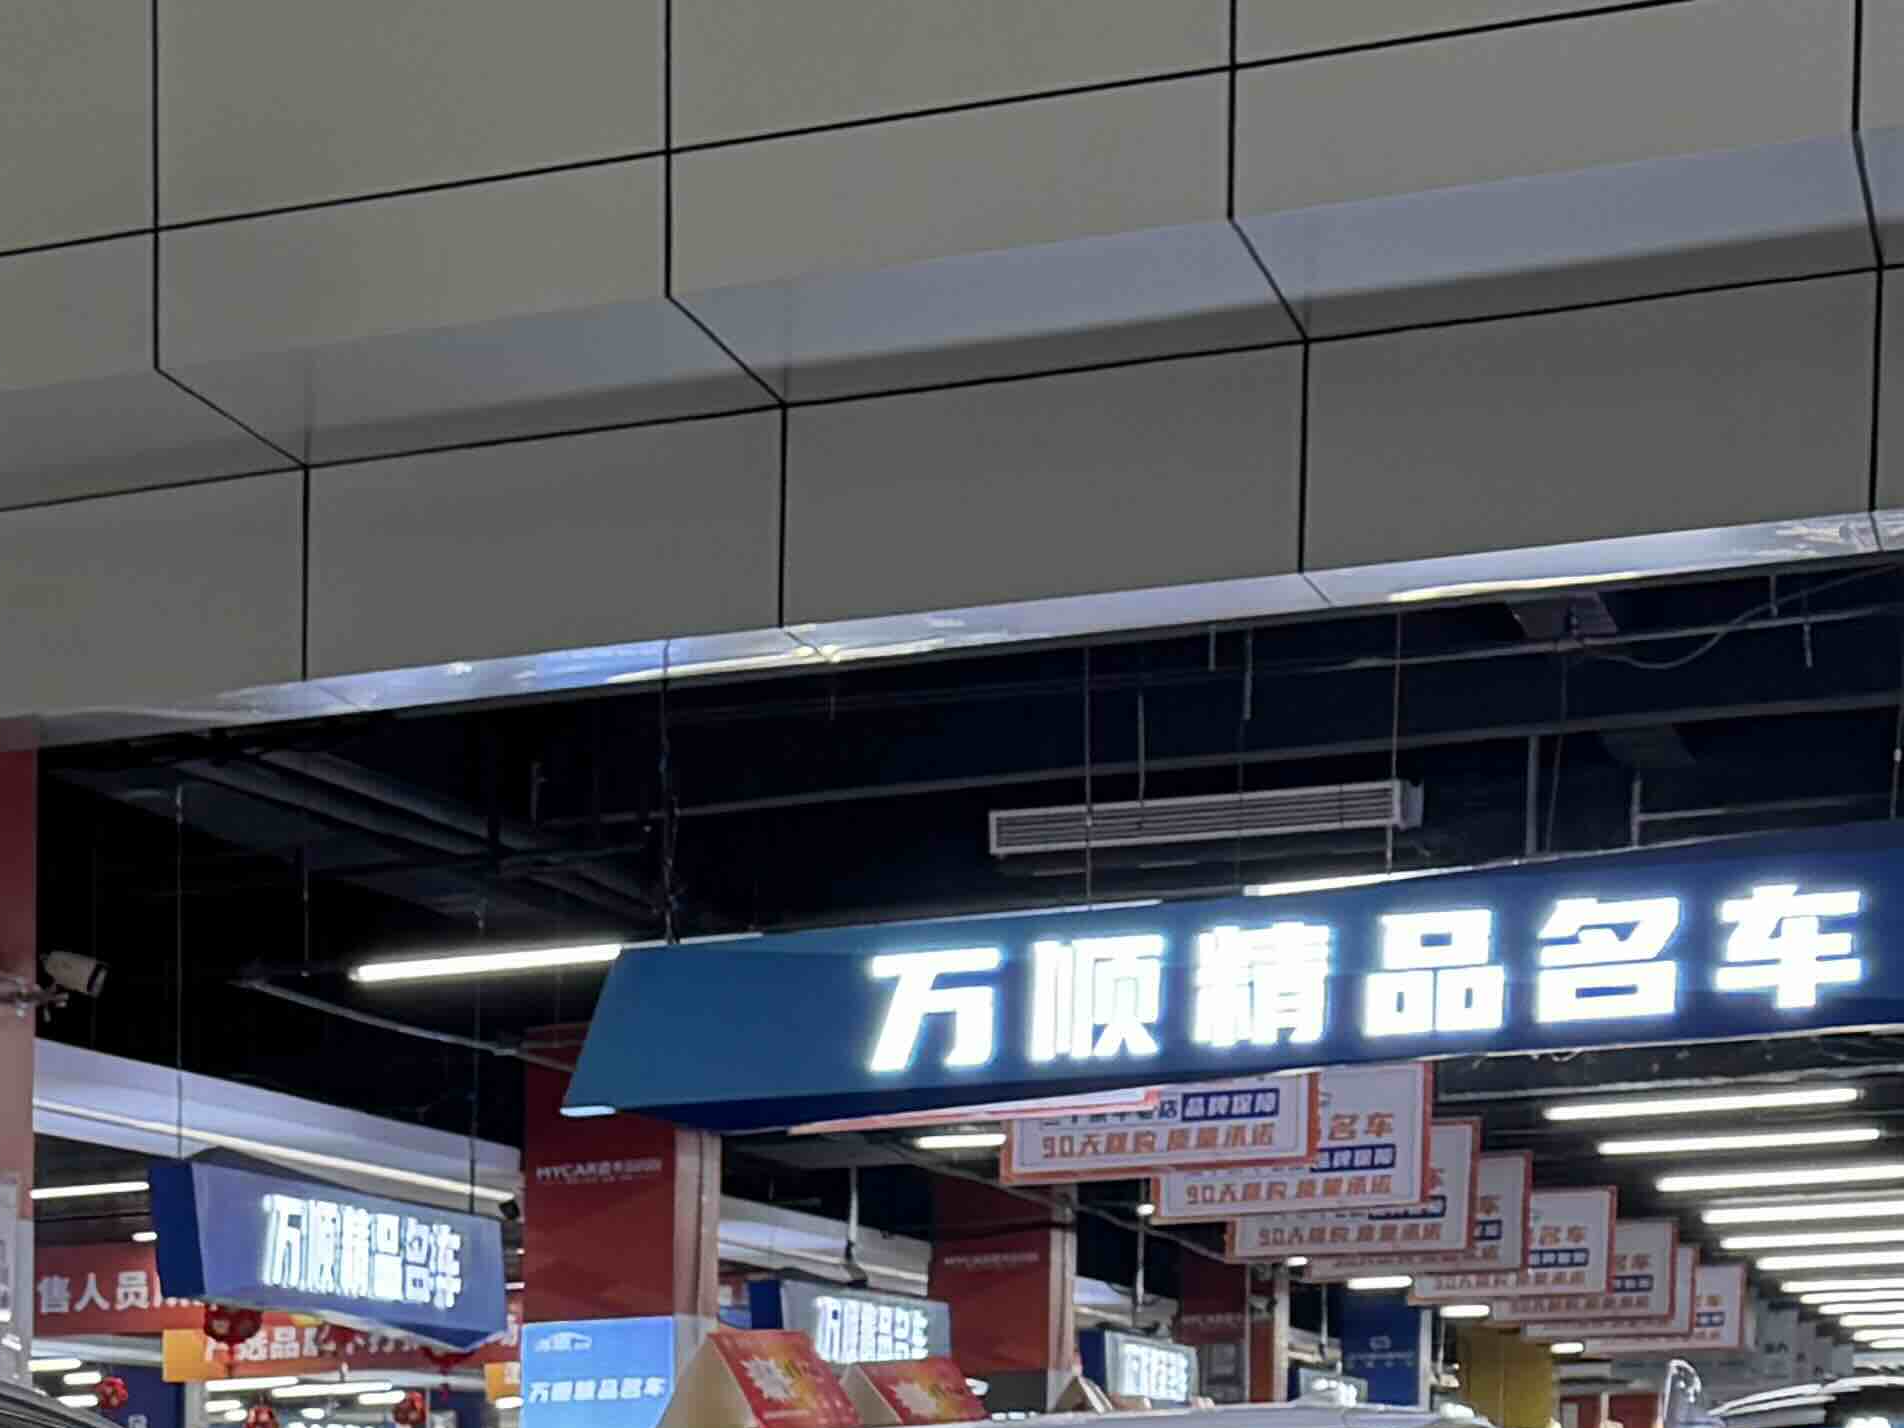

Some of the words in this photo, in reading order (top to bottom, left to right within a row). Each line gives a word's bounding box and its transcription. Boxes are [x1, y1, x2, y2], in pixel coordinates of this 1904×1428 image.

[867, 882, 1862, 1074] 万顺精品名车
